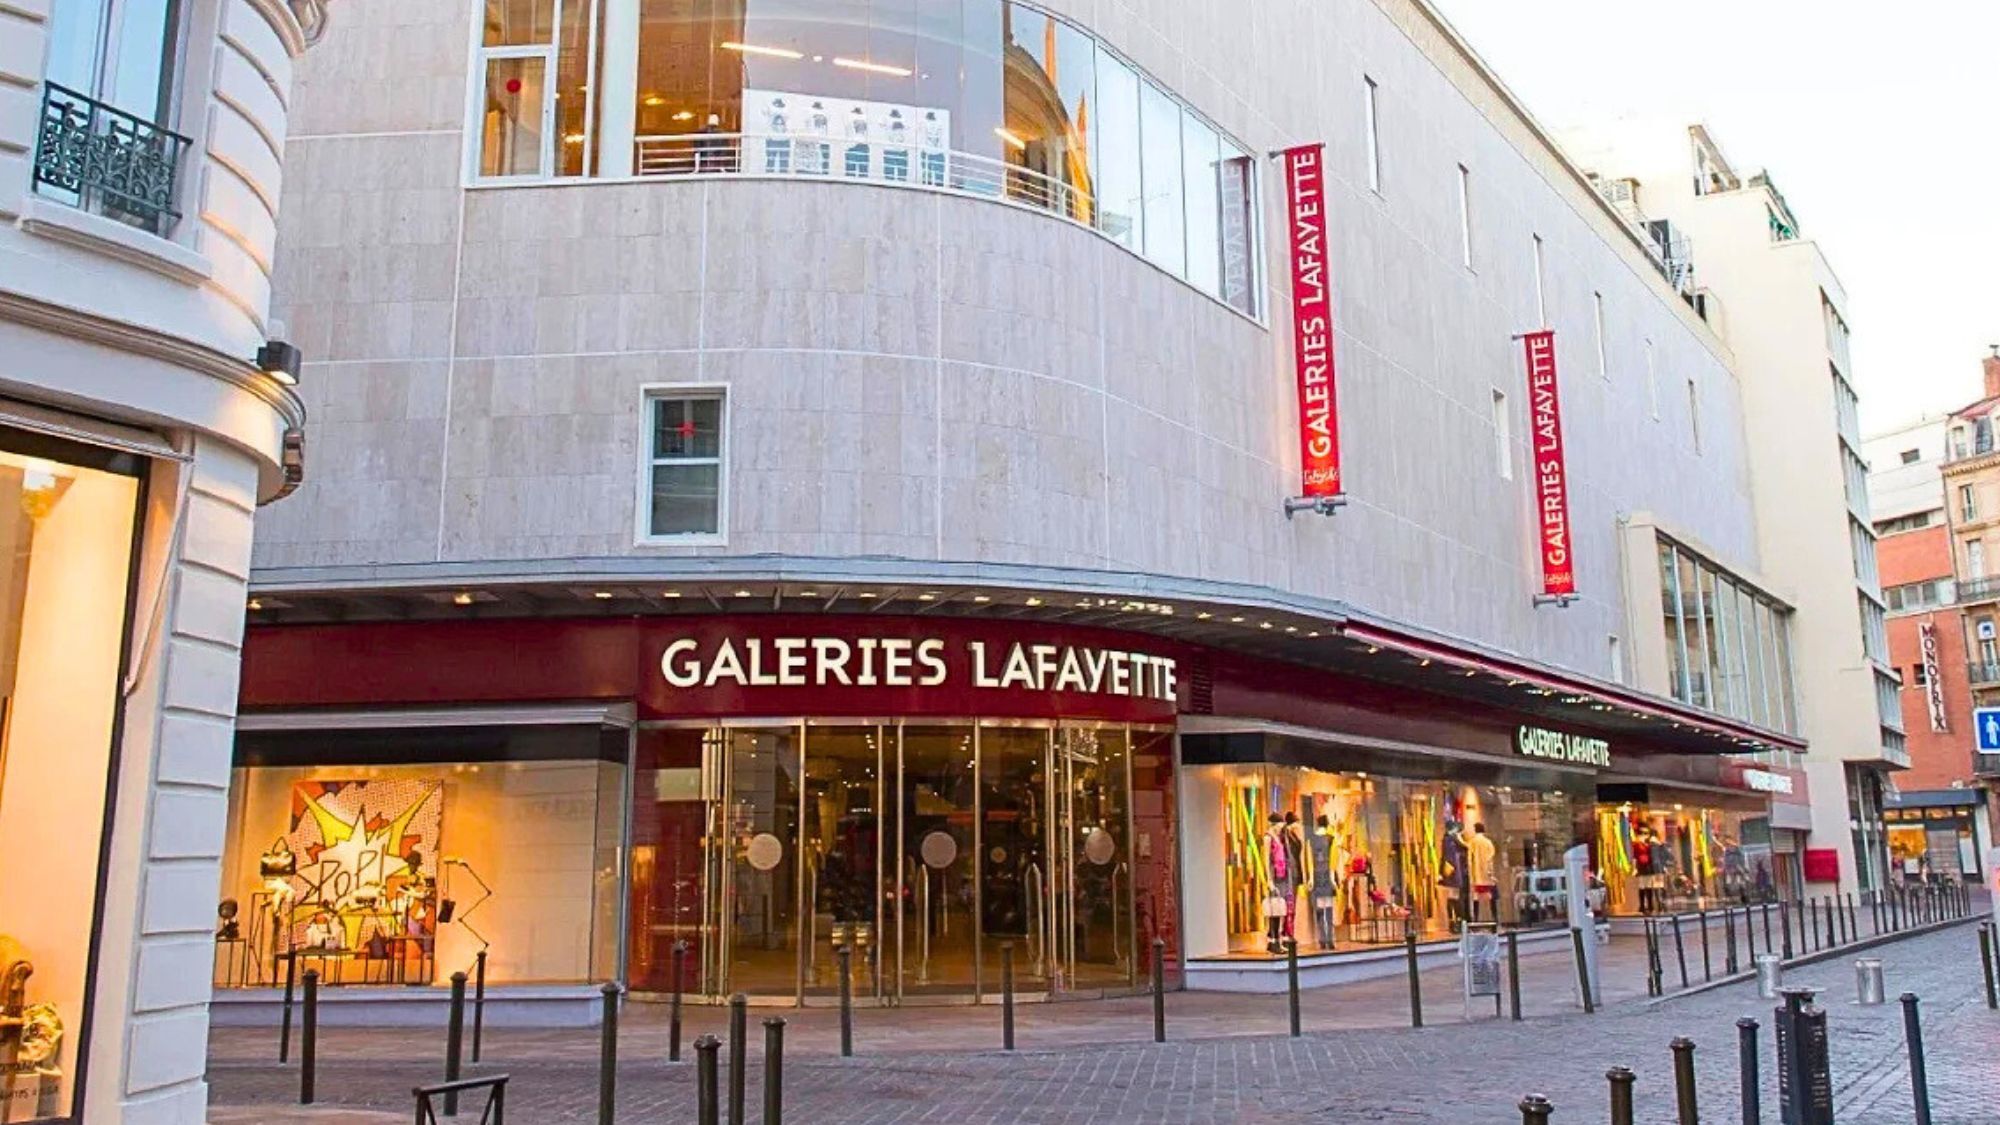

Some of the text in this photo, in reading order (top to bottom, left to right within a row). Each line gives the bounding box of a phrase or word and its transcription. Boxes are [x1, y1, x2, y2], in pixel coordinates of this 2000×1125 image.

[1293, 152, 1324, 307] LAFAYETTE
[1302, 316, 1332, 458] GALERIES
[1531, 337, 1557, 453] LAFAYETTE
[1541, 460, 1566, 566] GALERIES
[661, 638, 1177, 701] GALERIES LAFAYETTE
[1922, 625, 1945, 730] MONOPRIX
